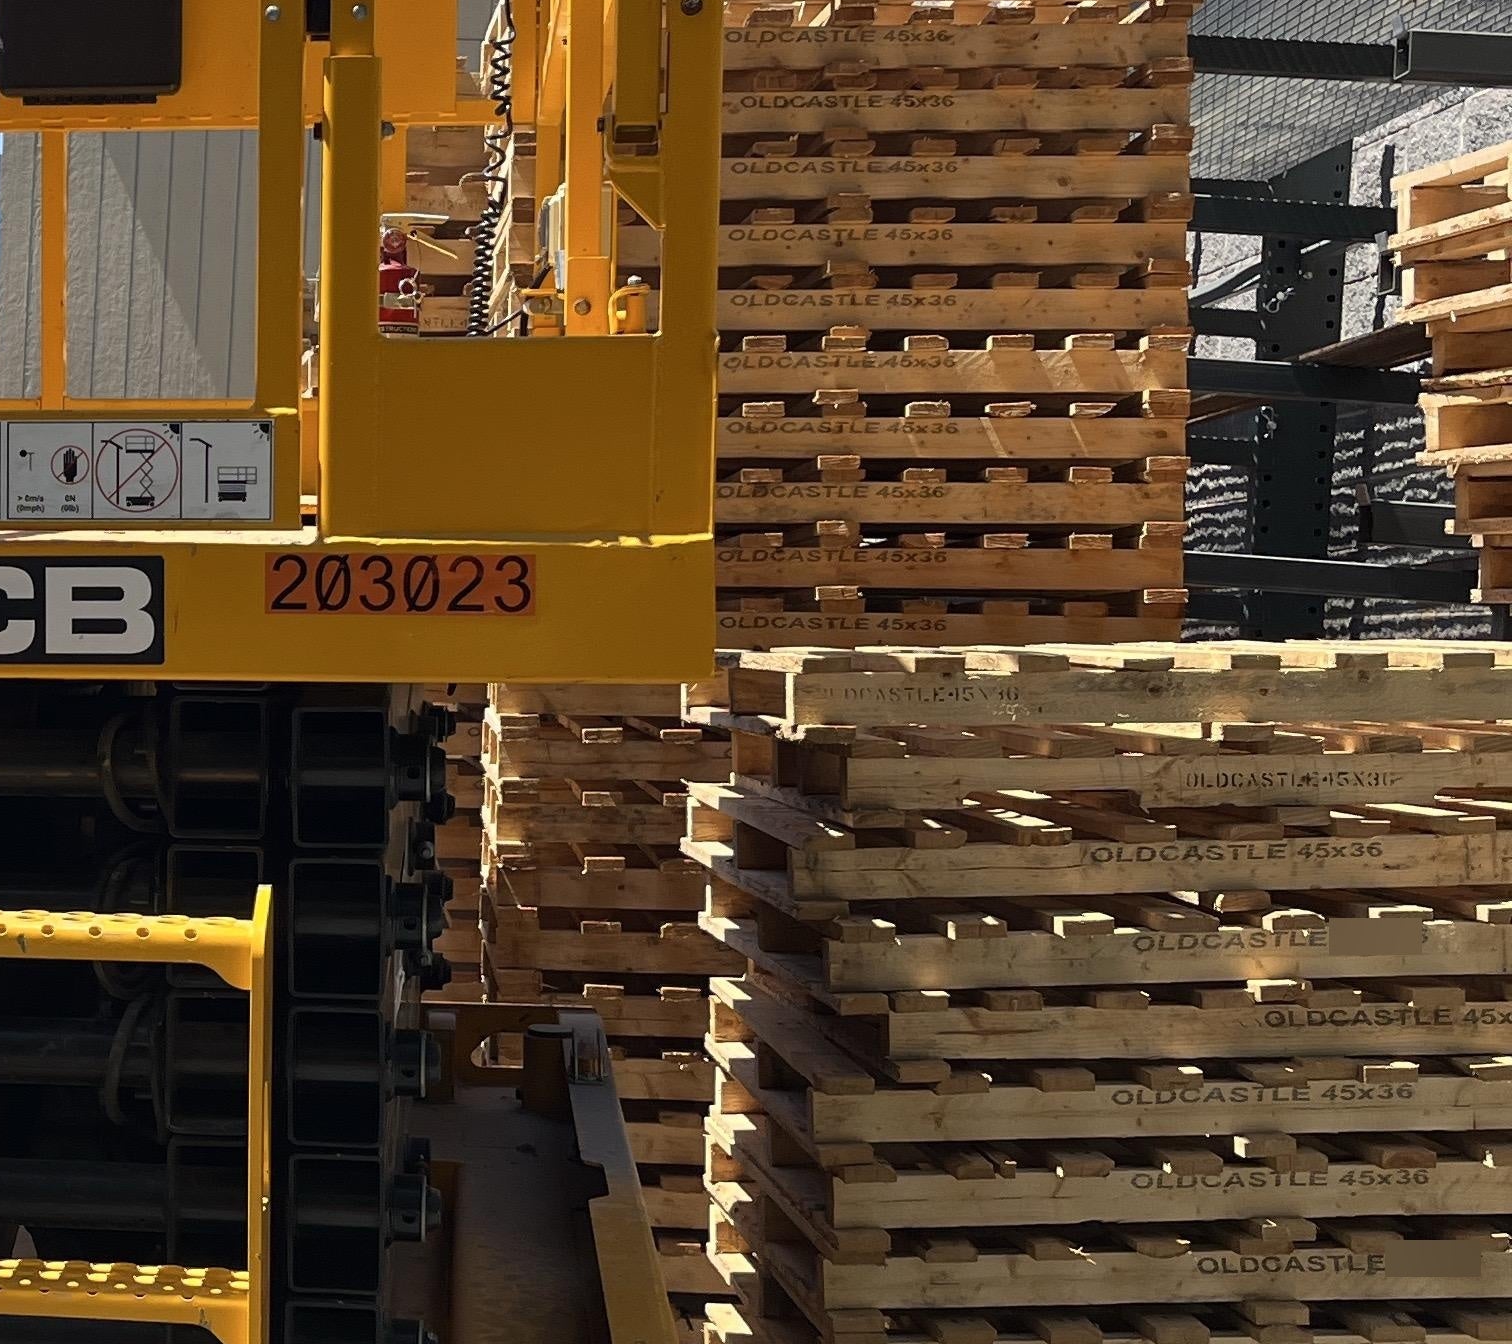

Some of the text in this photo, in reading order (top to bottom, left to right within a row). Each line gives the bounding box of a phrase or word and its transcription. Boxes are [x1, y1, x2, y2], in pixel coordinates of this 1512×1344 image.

[724, 29, 950, 44] OLDCASTLE 45x36
[740, 94, 955, 109] OLDCASTLE 45x36
[731, 160, 958, 175] OLDCASTLE 45x36
[727, 227, 953, 242] OLDCASTLE 45x36
[730, 293, 957, 307] OLDCASTLE 45x36
[722, 355, 879, 370] OLDCASTLE
[725, 421, 881, 434] OLDCASTLE
[717, 485, 945, 499] OLDCASTLE 45x36
[718, 549, 947, 563] OLDCASTLE 45x36
[271, 554, 532, 613] 203023
[720, 616, 947, 630] OLDCASTLE 45x36
[1090, 842, 1383, 863] OLDCASTLE 45x36
[1133, 929, 1327, 953] OLDCASTLE
[1264, 1008, 1453, 1028] OLDCASTLE
[1112, 1083, 1414, 1105] OLDCASTLE 45x36
[1131, 1169, 1430, 1190] OLDCASTLE 45x36
[1197, 1255, 1386, 1275] OLDCASTLE
